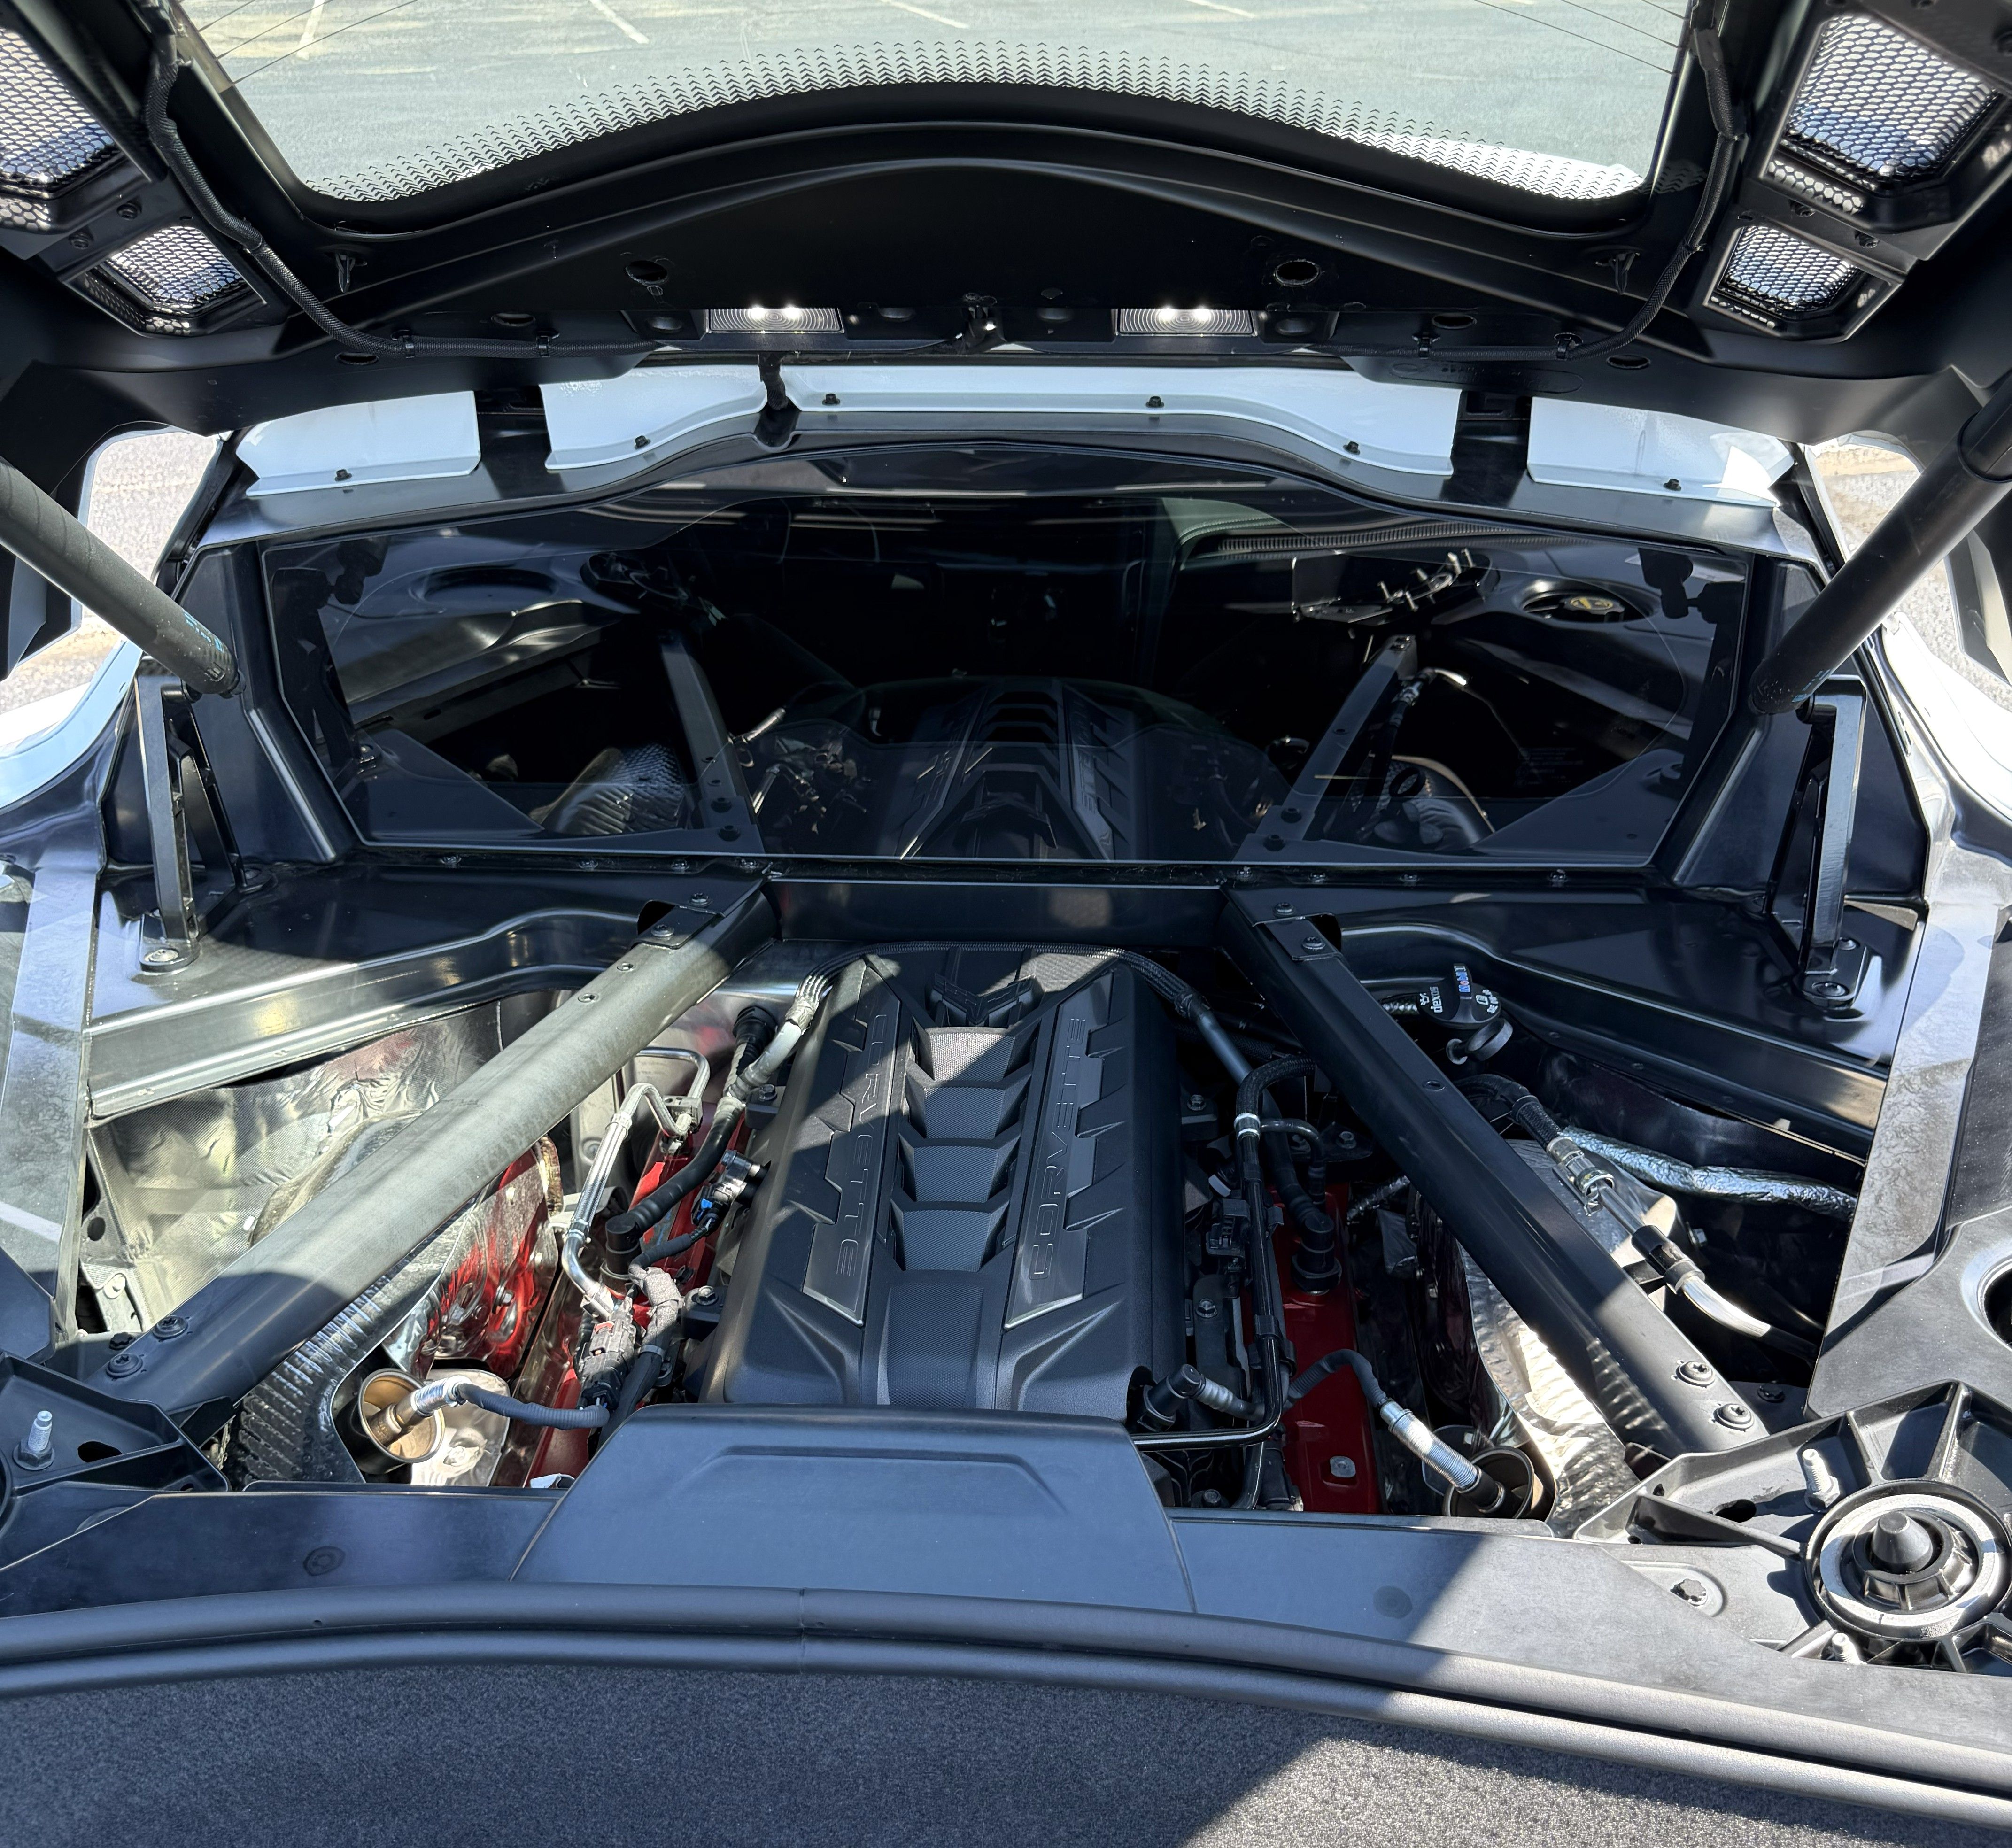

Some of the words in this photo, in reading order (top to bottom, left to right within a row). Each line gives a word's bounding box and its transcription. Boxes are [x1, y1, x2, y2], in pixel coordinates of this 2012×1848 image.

[1430, 986, 1443, 1013] dexos
[836, 1014, 887, 1276] CORVETTE
[1029, 1018, 1086, 1280] CORVETTE
